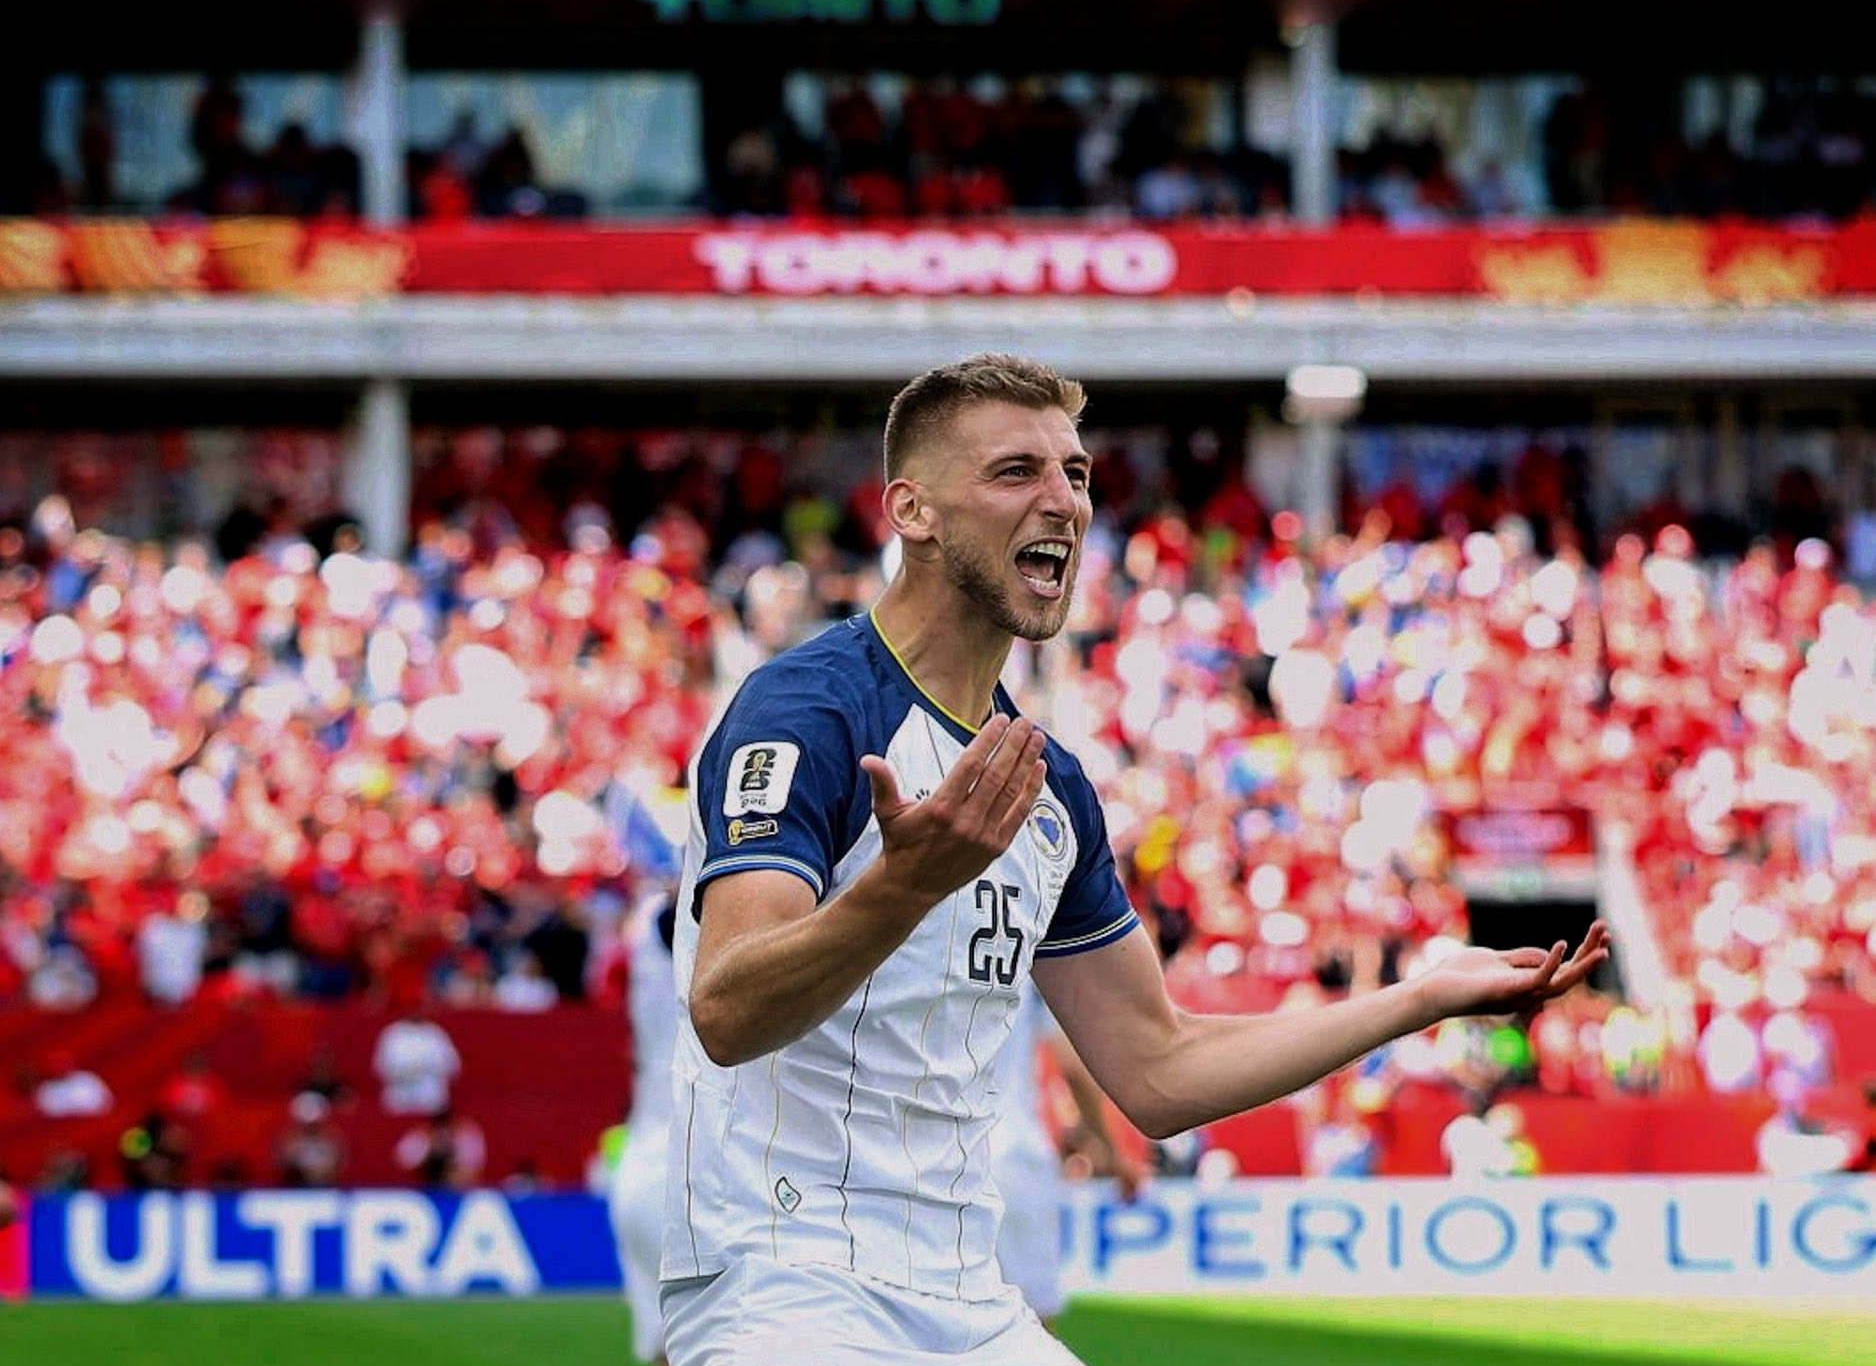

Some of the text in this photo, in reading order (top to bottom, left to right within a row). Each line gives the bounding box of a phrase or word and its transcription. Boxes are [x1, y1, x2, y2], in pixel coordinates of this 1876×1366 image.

[694, 230, 1178, 295] TORONTO
[969, 879, 1023, 986] 25
[66, 1189, 542, 1299] ULTRA
